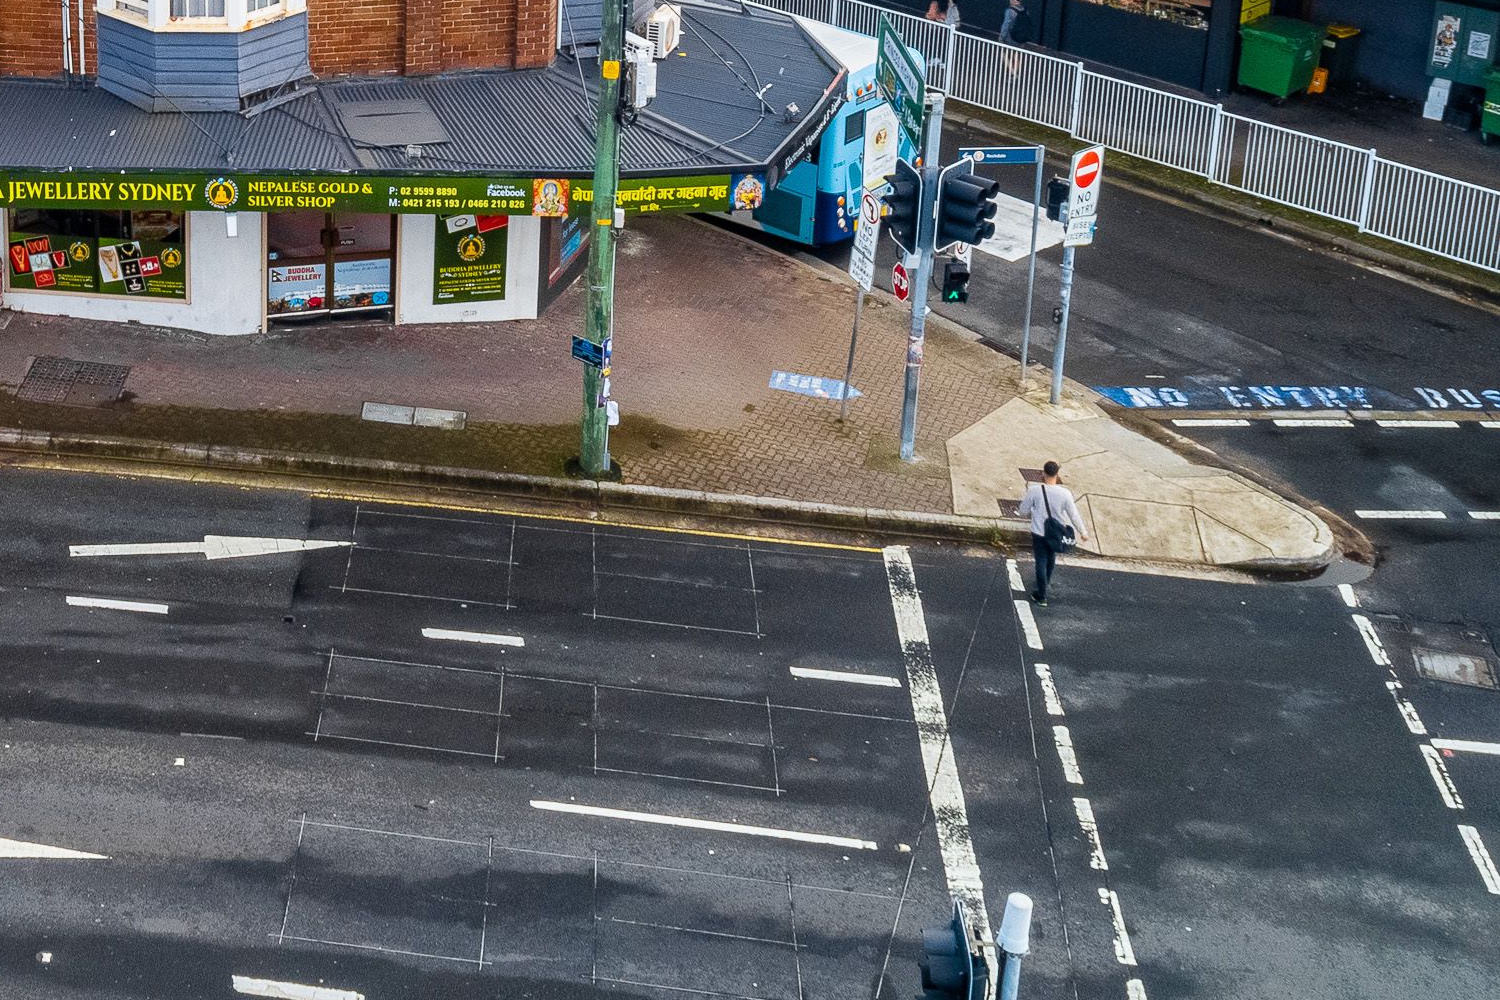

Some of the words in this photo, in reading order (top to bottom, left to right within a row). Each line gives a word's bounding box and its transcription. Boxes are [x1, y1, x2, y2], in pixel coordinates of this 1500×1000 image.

[7, 181, 115, 203] JEWELLERY
[118, 183, 196, 202] SYDNEY
[248, 181, 315, 194] NEPALESE
[318, 182, 355, 194] GOLD
[358, 183, 373, 194] &
[389, 187, 398, 195] P:
[400, 187, 411, 196] 02
[413, 187, 434, 196] 9599
[436, 187, 457, 196] 8890
[487, 189, 525, 197] Facebook
[572, 186, 594, 202] नेपा
[676, 186, 708, 199] गहना
[708, 184, 728, 200] गृह
[248, 195, 294, 207] SILVER
[297, 196, 336, 208] SHOP
[389, 199, 400, 207] M:
[402, 199, 423, 207] 0421
[425, 199, 442, 208] 215
[444, 199, 460, 208] 193
[468, 199, 488, 208] 0466
[491, 200, 507, 208] 210
[509, 200, 525, 209] 826
[1076, 191, 1092, 204] NO
[1070, 204, 1094, 219] ENTRY
[862, 220, 873, 237] NO
[288, 266, 315, 274] BUDDHA
[285, 273, 321, 281] JEWELLERY
[1122, 387, 1189, 408] NO
[1219, 386, 1373, 409] ENTRY
